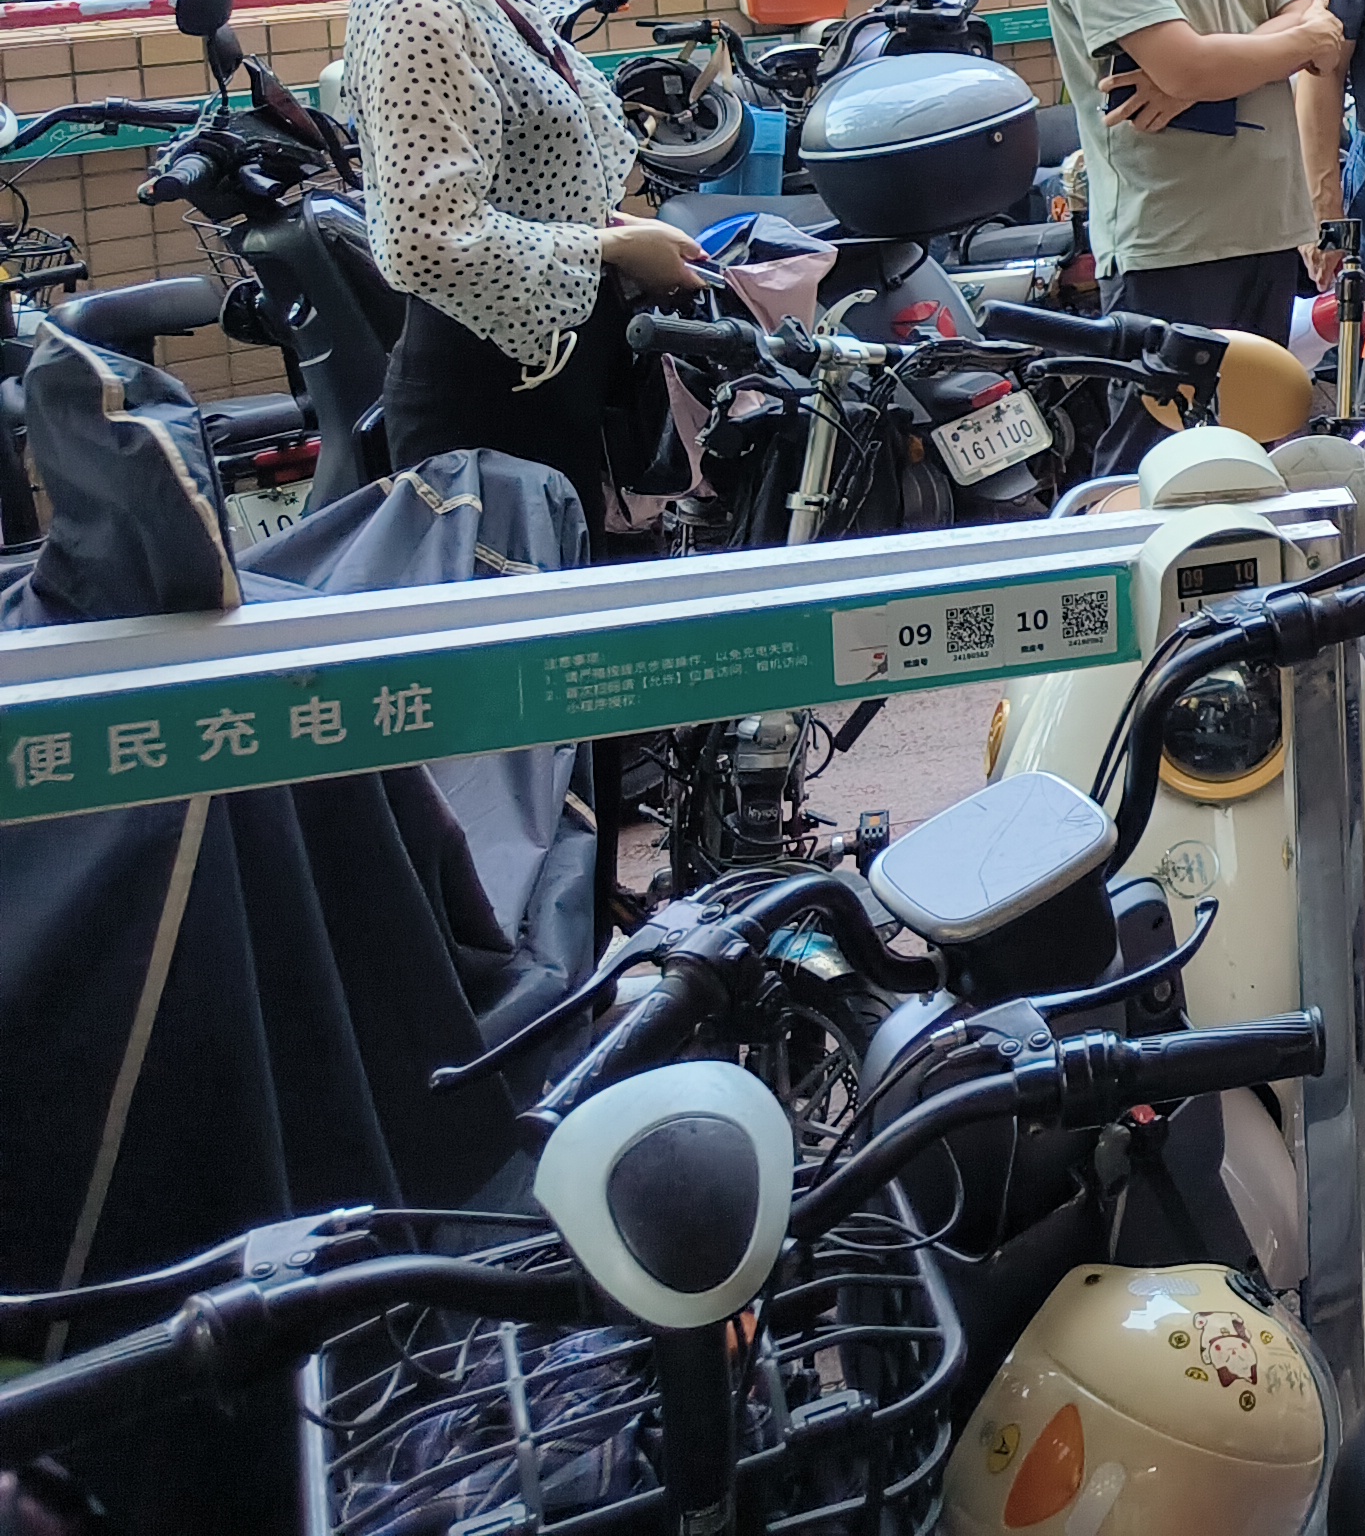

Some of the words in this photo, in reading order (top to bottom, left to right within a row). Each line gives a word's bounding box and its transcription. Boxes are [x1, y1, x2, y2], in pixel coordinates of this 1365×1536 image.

[1016, 609, 1049, 633] 10
[898, 623, 932, 647] 09
[8, 682, 435, 789] 便民充电桩
